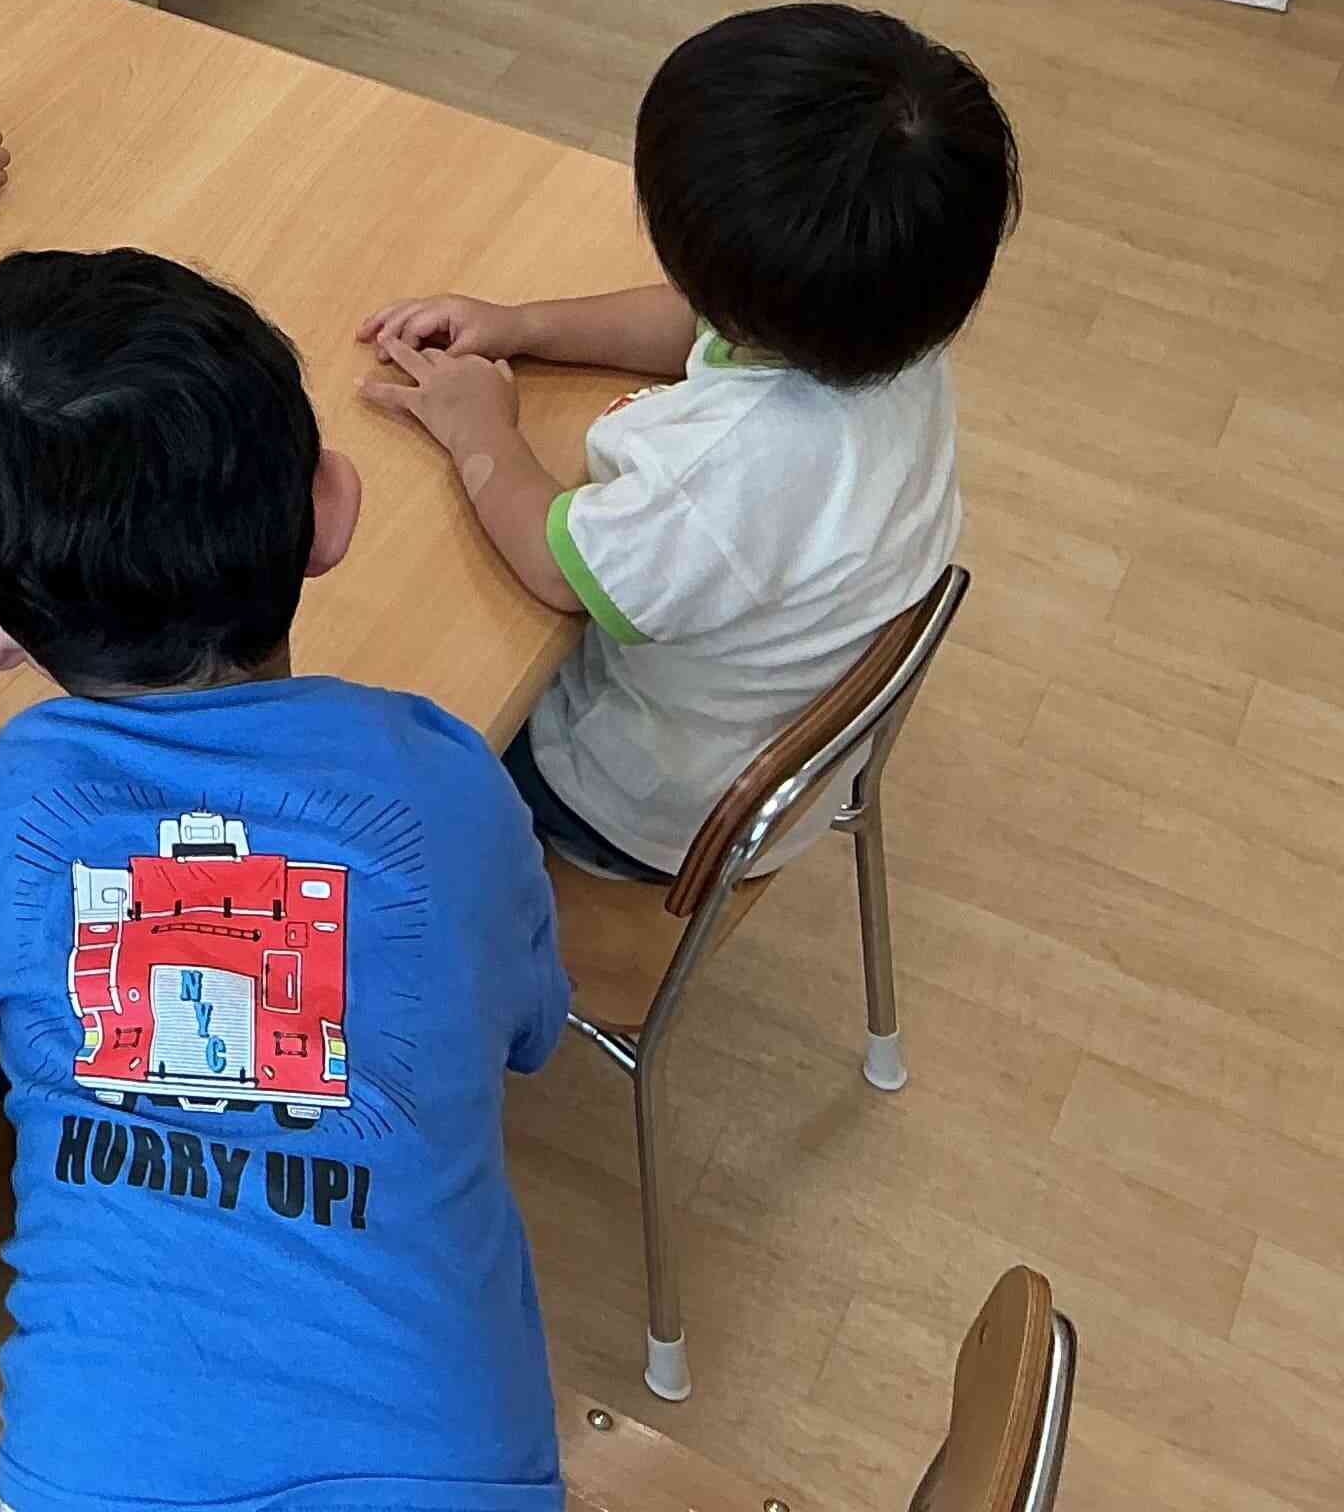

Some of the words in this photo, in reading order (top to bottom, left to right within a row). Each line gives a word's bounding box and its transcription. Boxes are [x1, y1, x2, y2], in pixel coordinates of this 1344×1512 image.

[180, 970, 227, 1074] NYC
[55, 1115, 251, 1210] HURRY
[265, 1150, 370, 1230] UP!
